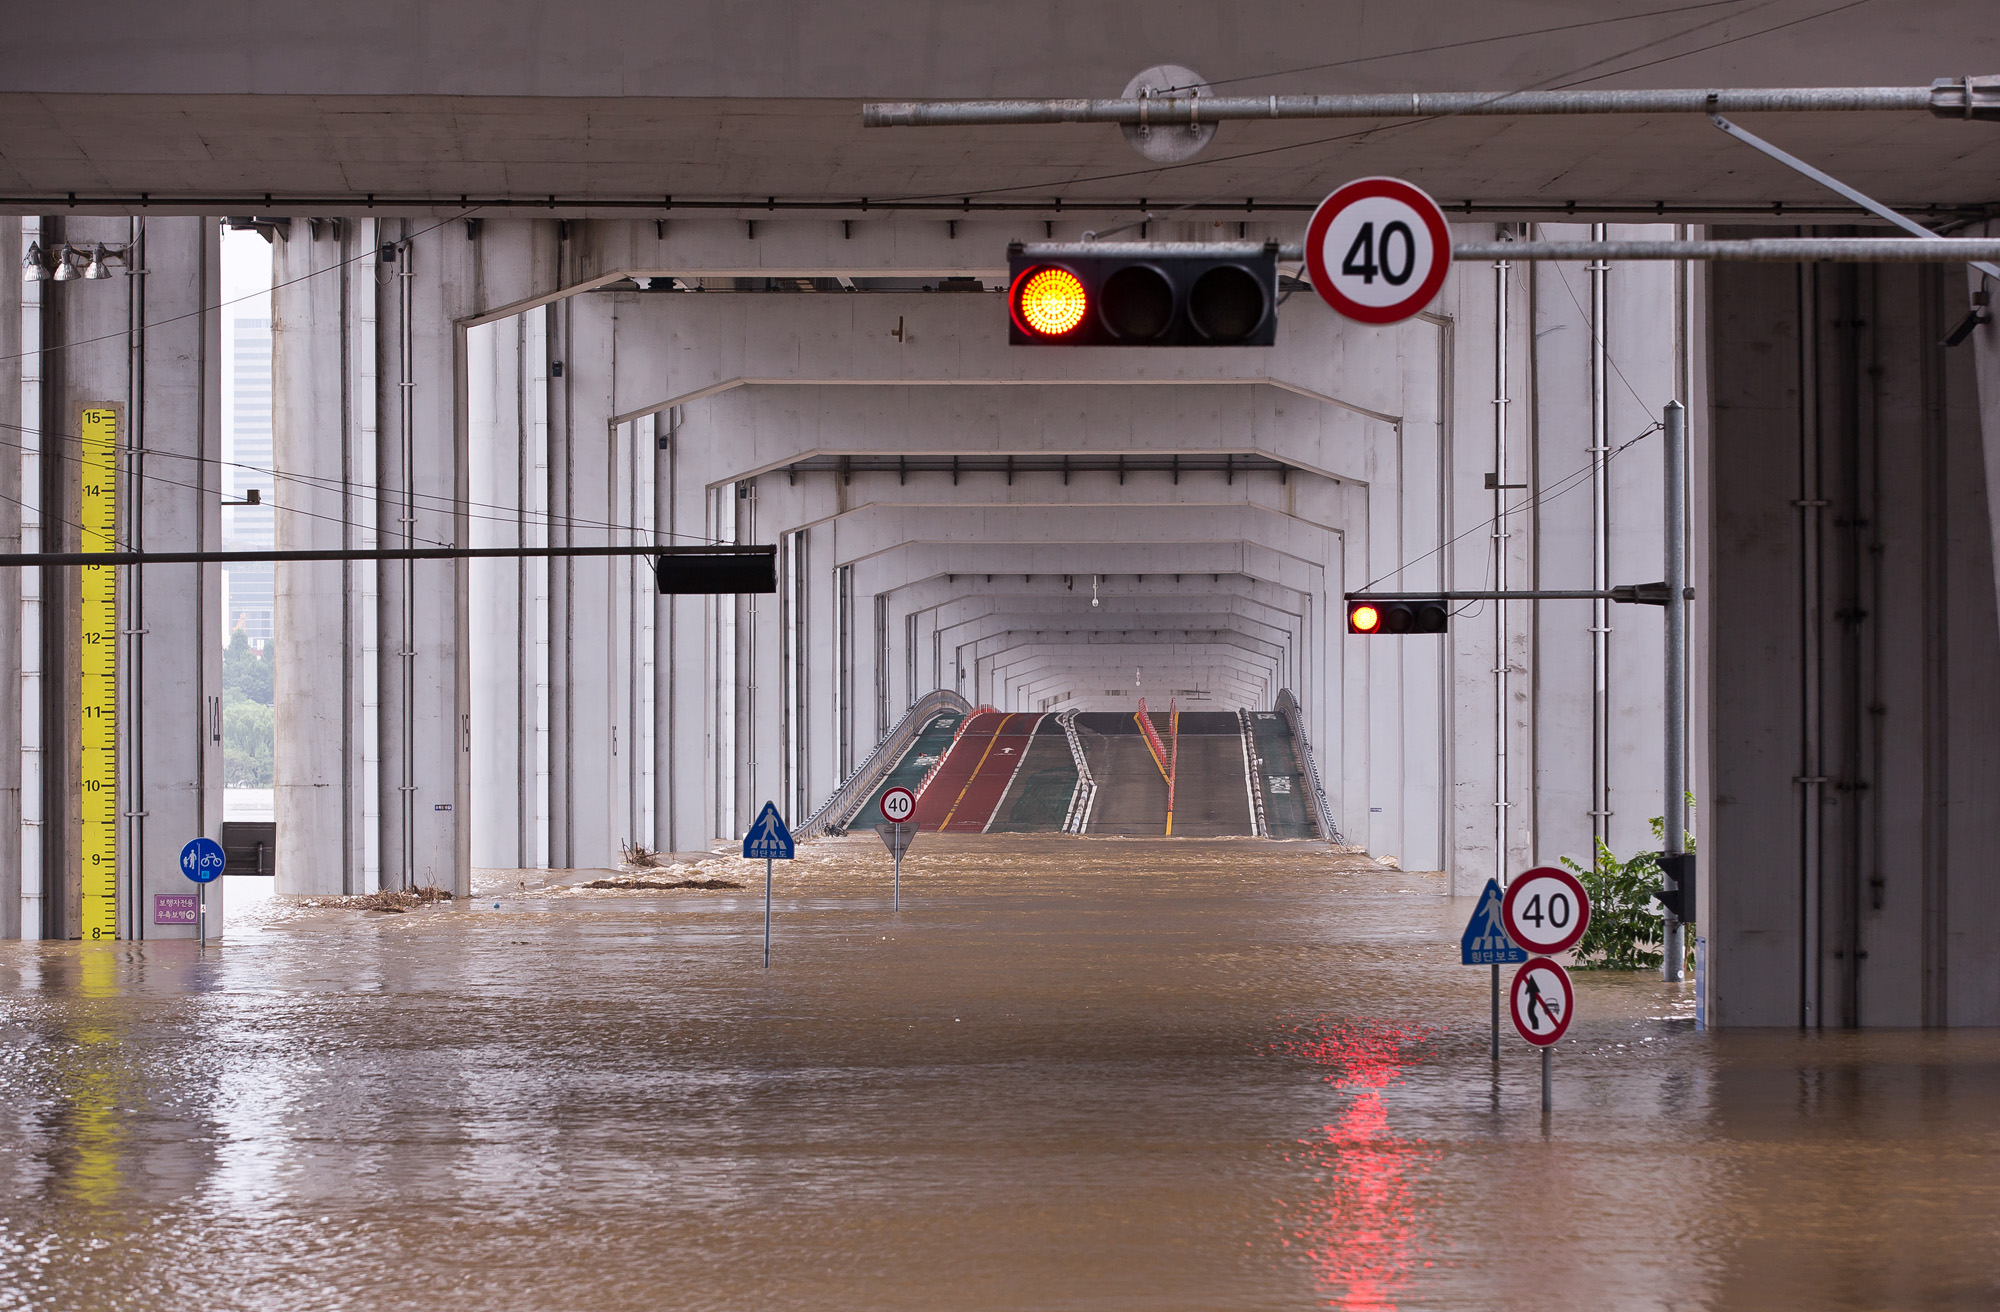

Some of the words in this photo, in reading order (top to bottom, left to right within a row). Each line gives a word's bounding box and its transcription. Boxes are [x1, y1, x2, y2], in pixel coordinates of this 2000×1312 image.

[1342, 221, 1416, 286] 40
[85, 412, 101, 424] 15
[85, 485, 100, 497] 14
[85, 632, 101, 644] 12
[85, 706, 101, 718] 11
[85, 780, 101, 792] 10
[888, 797, 908, 813] 40
[92, 854, 101, 865] 9
[750, 849, 788, 858] 횡단보도
[159, 898, 194, 907] 보행자전용
[1522, 893, 1570, 928] 40
[92, 927, 101, 939] 8
[1471, 951, 1519, 962] 횡단보도
